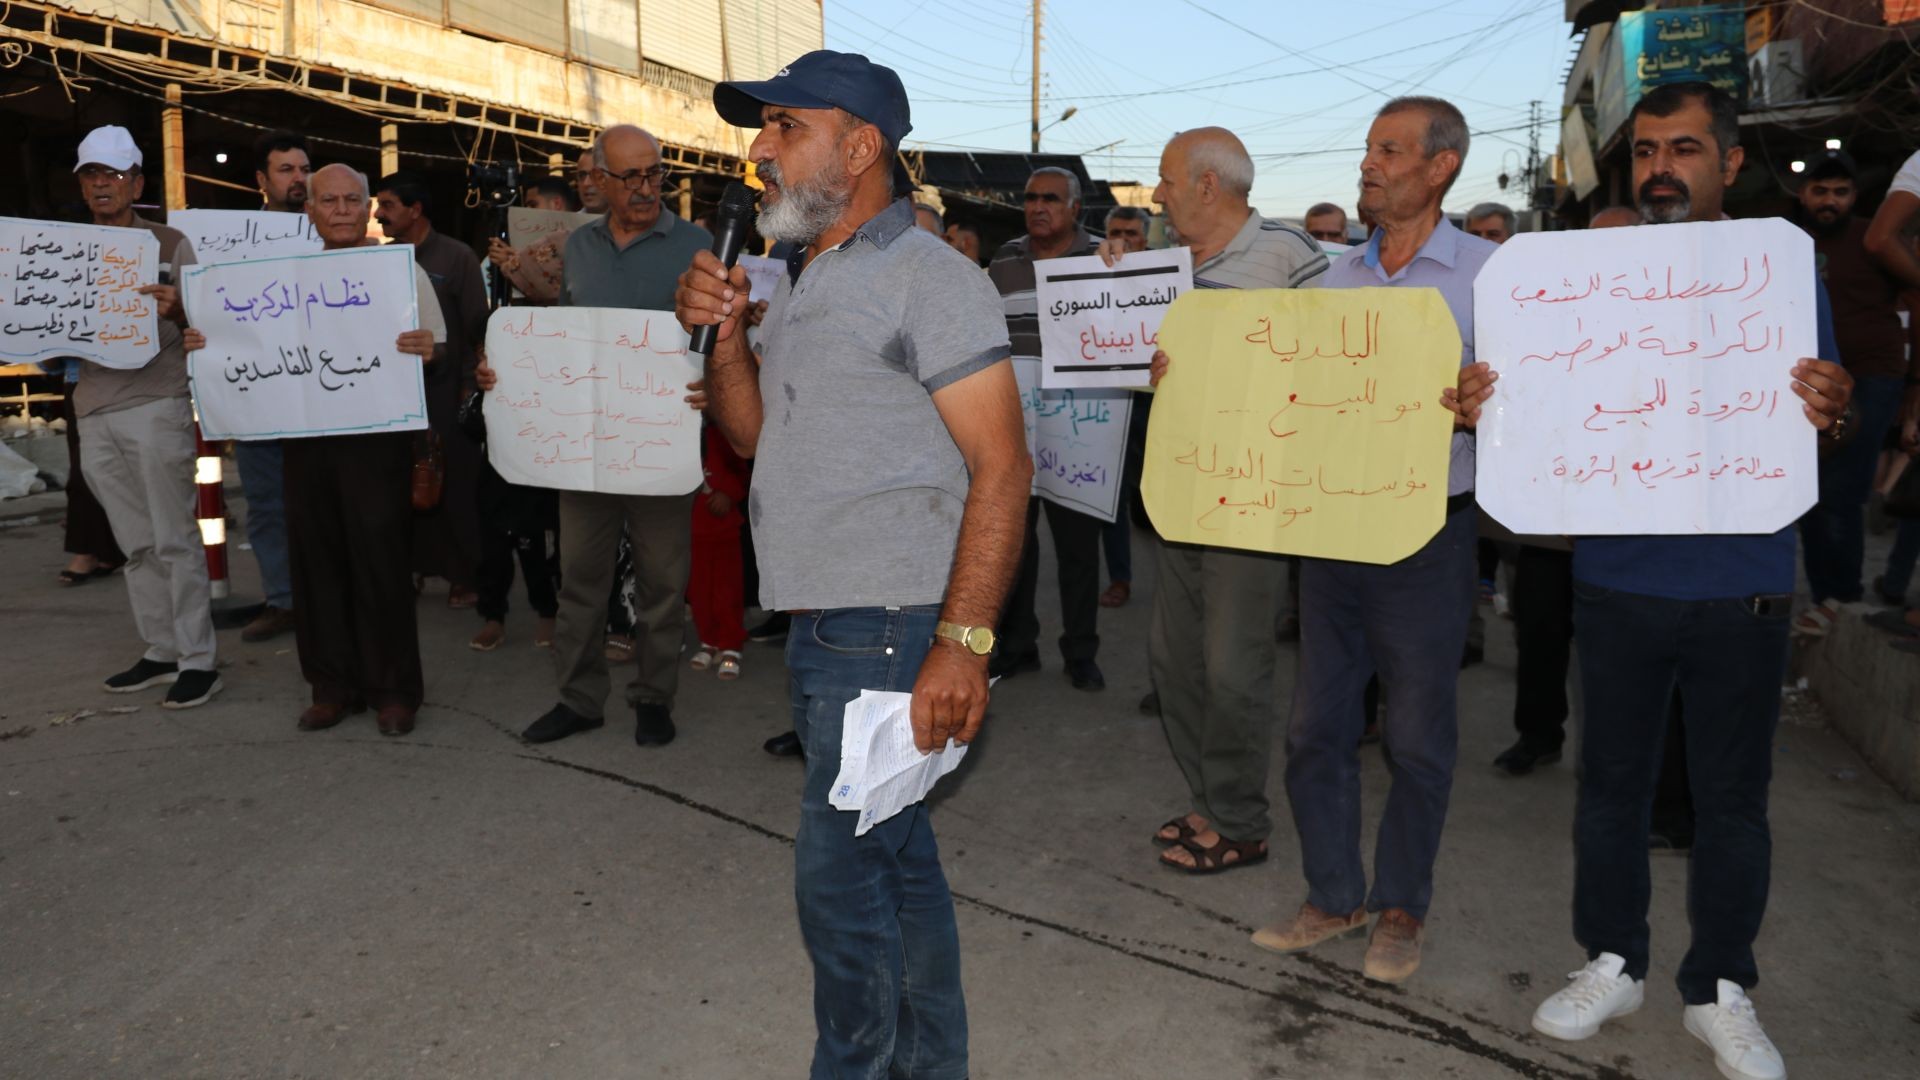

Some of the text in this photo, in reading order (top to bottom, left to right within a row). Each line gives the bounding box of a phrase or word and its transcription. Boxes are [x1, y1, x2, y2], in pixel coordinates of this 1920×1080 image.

[198, 218, 260, 251] بالتوزيع
[1511, 253, 1771, 308] السلطة للشعب
[216, 278, 371, 329] نظام المركزية
[1050, 286, 1177, 321] الشعب السوري
[68, 315, 96, 343] راح
[1080, 324, 1134, 360] بينباع
[1245, 309, 1380, 365] البلدية
[1638, 310, 1783, 359] الكرامة
[224, 345, 381, 391] منبع للفاسدين
[1269, 377, 1376, 437] للبيع
[1583, 378, 1777, 431] الثروة للجميع
[1067, 462, 1106, 487] الخبز
[1175, 442, 1427, 499] مؤسسات الدولة
[1632, 452, 1701, 489] توزيع
[1709, 455, 1729, 480] في
[1735, 457, 1786, 480] عدالة
[1197, 490, 1312, 531] مو للبيع
